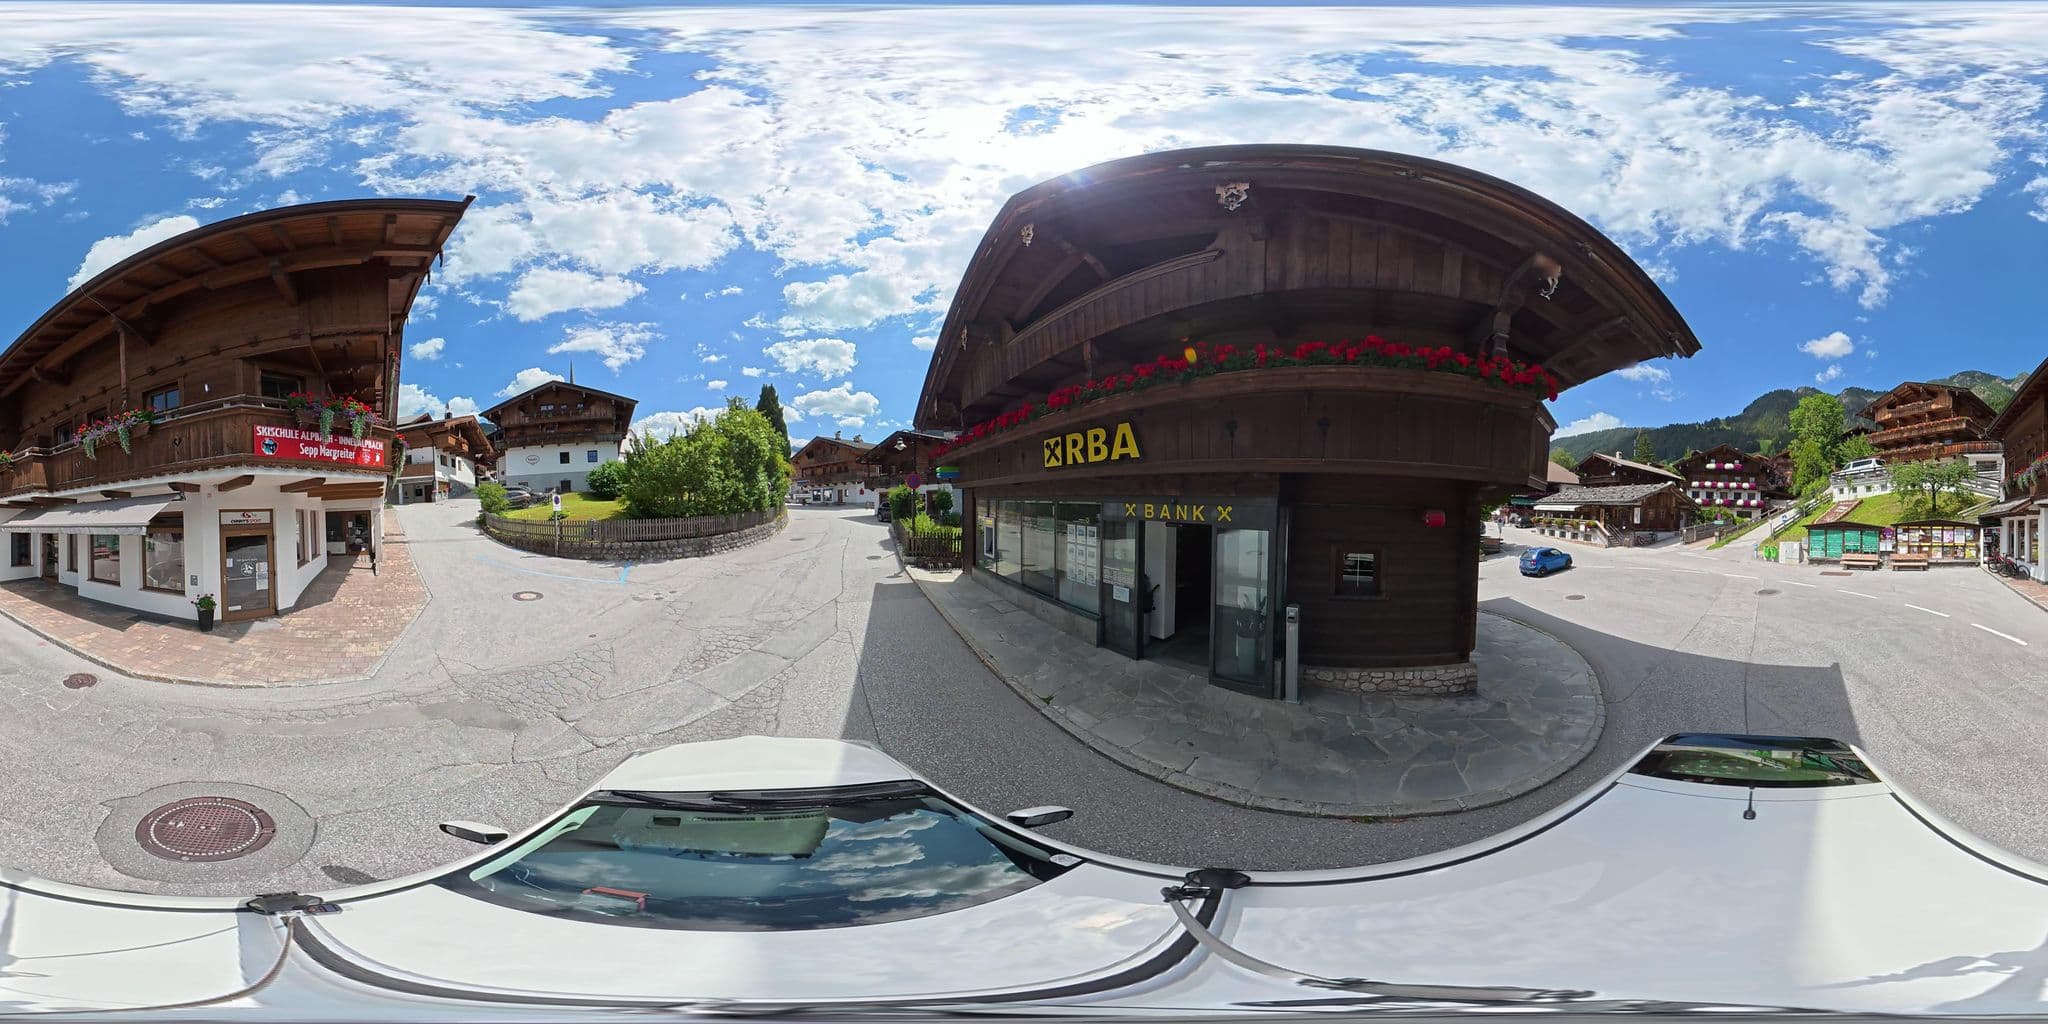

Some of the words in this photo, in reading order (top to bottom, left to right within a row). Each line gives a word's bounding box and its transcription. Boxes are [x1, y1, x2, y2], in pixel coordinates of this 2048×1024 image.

[256, 426, 299, 439] SKISCHULE
[300, 431, 333, 443] ALPBH
[339, 435, 383, 450] INNEALPBACH
[1066, 422, 1140, 464] RBA
[299, 443, 319, 458] Sepp
[319, 444, 356, 460] Margreiter
[1144, 503, 1205, 522] BANK
